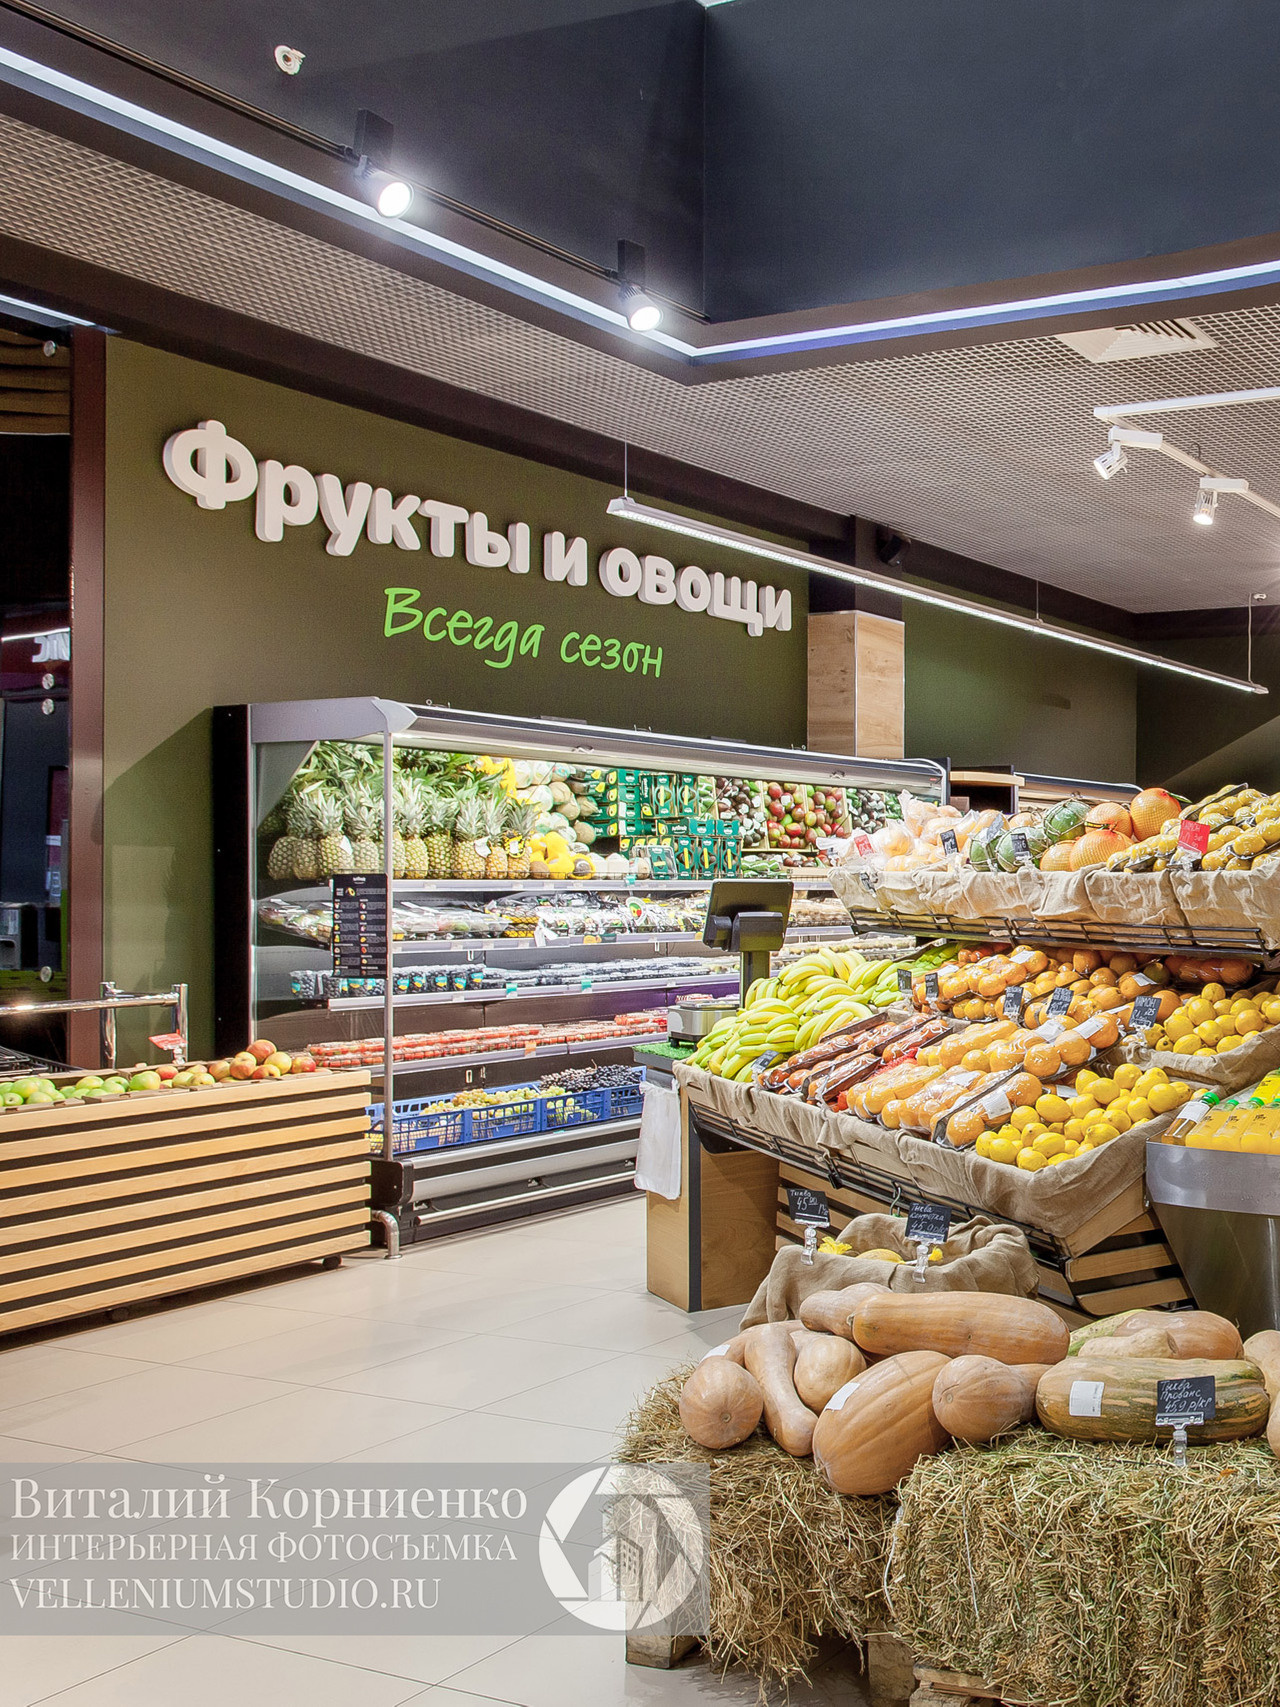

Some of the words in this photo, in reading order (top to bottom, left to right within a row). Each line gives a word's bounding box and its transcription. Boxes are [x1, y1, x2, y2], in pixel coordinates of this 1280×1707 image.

[163, 420, 530, 574] Фрукты
[544, 531, 588, 586] и
[599, 547, 792, 636] овощи
[384, 588, 545, 669] Всегда
[560, 632, 663, 678] сезон
